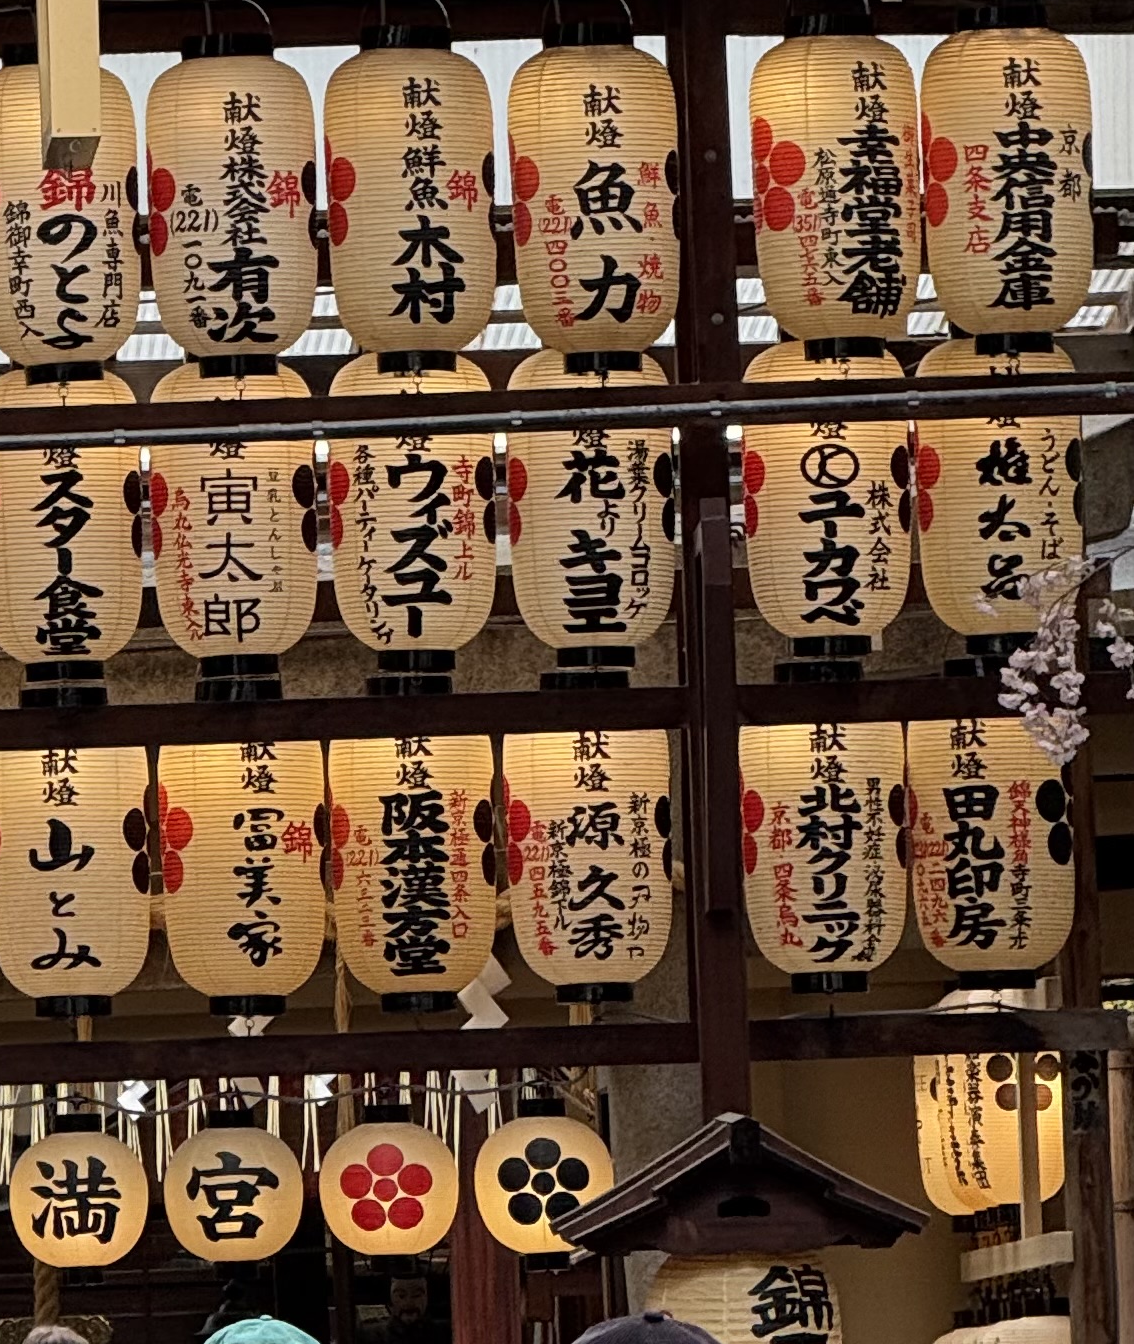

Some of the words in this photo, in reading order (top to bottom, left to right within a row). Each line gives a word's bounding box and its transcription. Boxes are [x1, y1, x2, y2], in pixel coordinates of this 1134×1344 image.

[223, 91, 264, 156] 献燈
[402, 77, 443, 141] 献燈
[583, 83, 624, 149] 献燈
[851, 60, 889, 124] 献燈
[1002, 56, 1043, 120] 献燈
[219, 156, 269, 247] 株式会社
[266, 170, 301, 219] 錦
[401, 143, 448, 211] 鮮魚
[446, 170, 479, 212] 錦
[963, 144, 993, 254] 四条支店
[1058, 123, 1081, 203] 京都
[94, 180, 123, 328] 川魚専門店
[570, 159, 643, 324] 魚力
[987, 121, 1058, 311] 中央信用金庫
[206, 248, 280, 344] 有次
[388, 215, 466, 324] 木村
[31, 469, 104, 656] スター食堂
[198, 468, 263, 643] 寅太郎
[381, 453, 454, 638] ウィズユー
[865, 479, 894, 592] 株式会社
[41, 749, 80, 807] 献燈
[240, 742, 279, 794] 献燈
[395, 736, 434, 789] 献燈
[572, 731, 611, 792] 献燈
[809, 723, 848, 783] 献燈
[950, 720, 988, 780] 献燈
[281, 820, 313, 864] 錦
[796, 784, 863, 963] 北村クリニック
[943, 784, 1006, 950] 田丸印房
[28, 818, 102, 971] 山とみ
[378, 790, 451, 976] 阪本漢方堂
